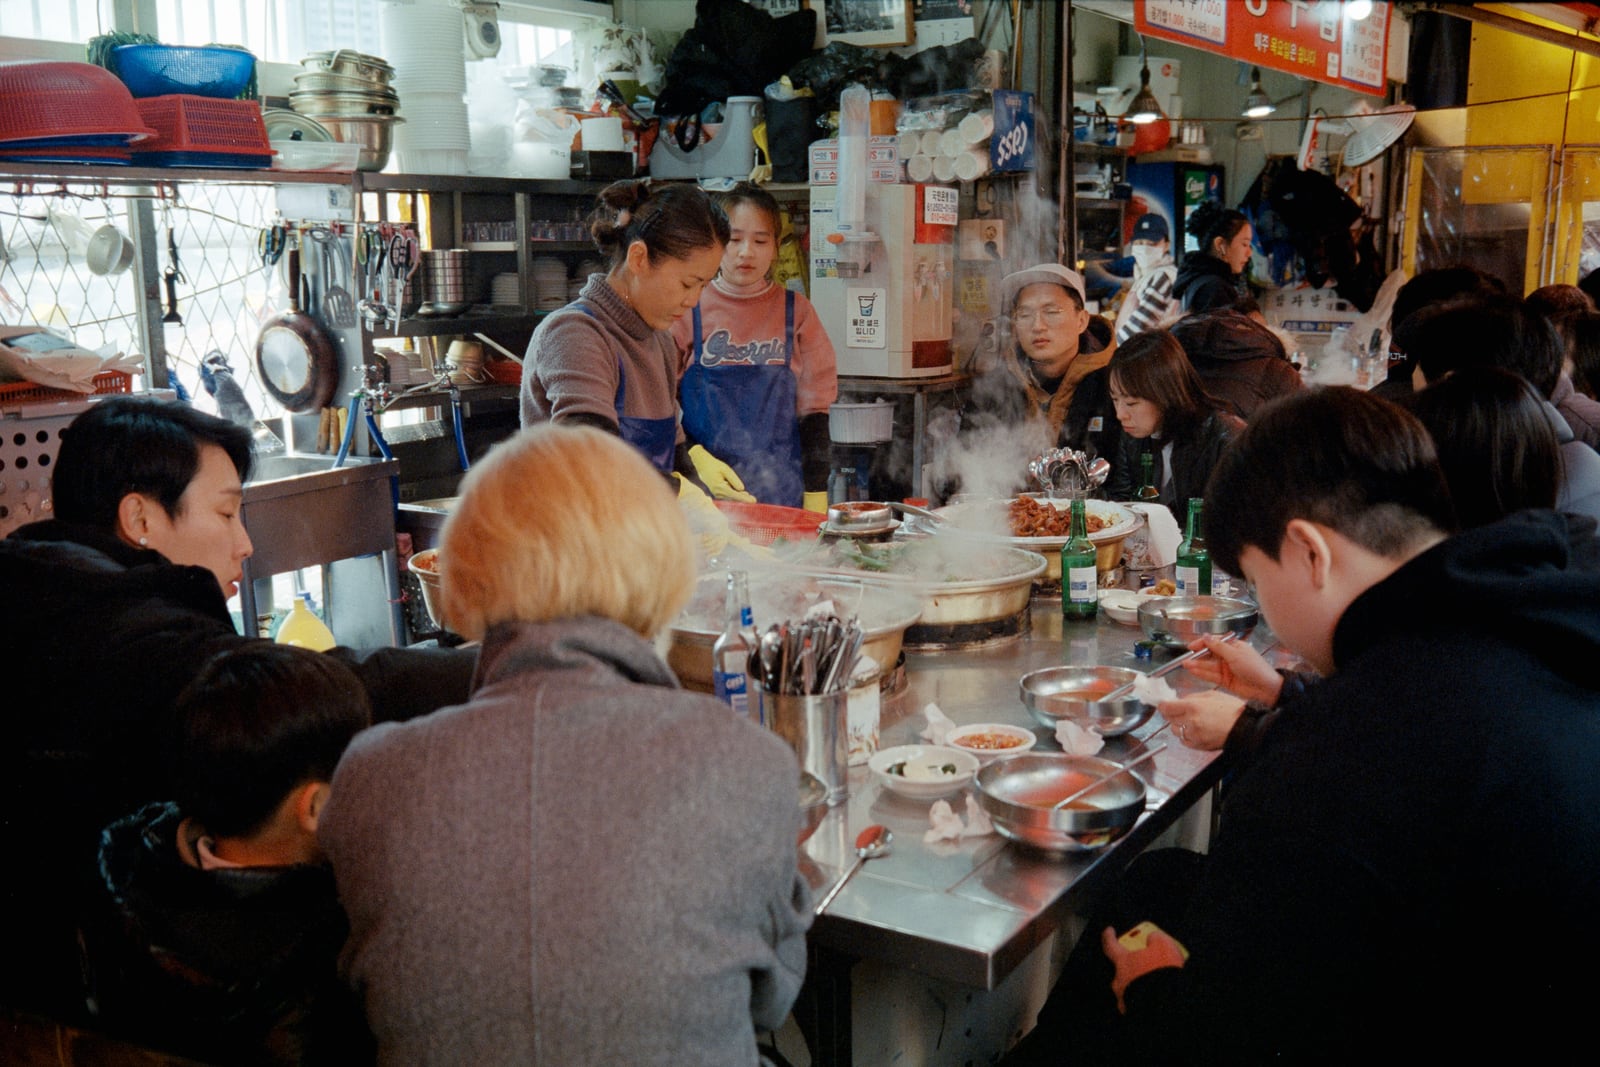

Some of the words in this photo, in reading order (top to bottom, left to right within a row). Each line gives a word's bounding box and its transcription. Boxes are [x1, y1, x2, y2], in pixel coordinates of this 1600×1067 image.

[953, 31, 960, 41] 2
[1254, 33, 1269, 53] 매주
[852, 319, 865, 327] 물은
[867, 319, 879, 328] 셀프
[855, 327, 876, 336] 입니다
